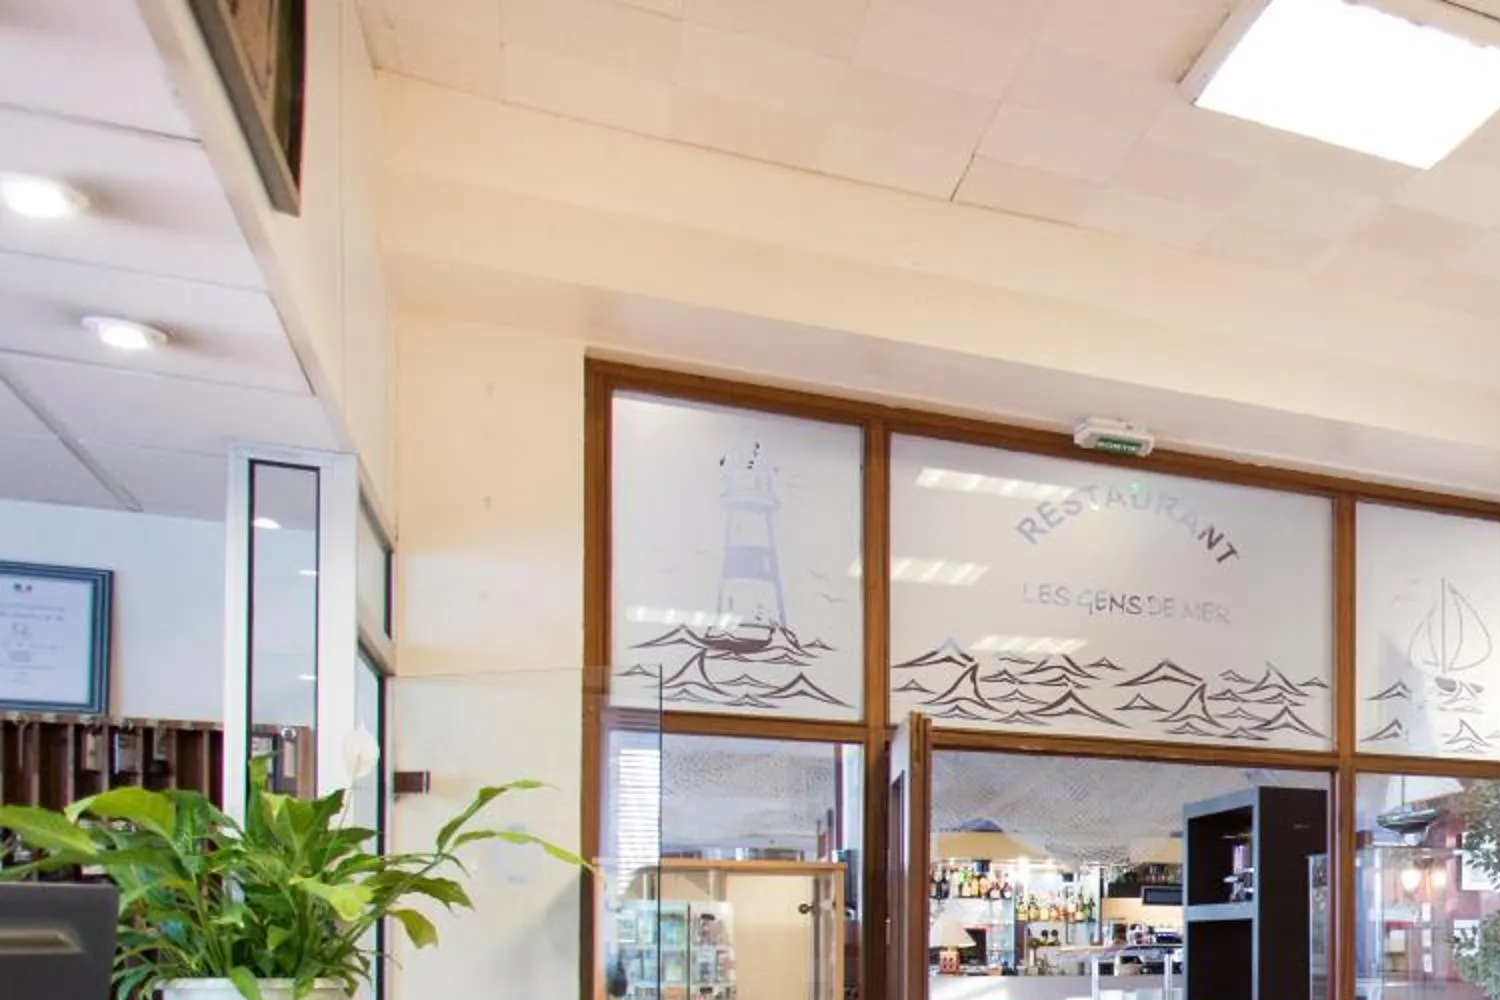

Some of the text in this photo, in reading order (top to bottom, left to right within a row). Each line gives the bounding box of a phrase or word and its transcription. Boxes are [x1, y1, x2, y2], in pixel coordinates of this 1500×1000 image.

[1015, 484, 1240, 564] RESTAURANT
[1022, 582, 1232, 625] LES GENS DE MER
